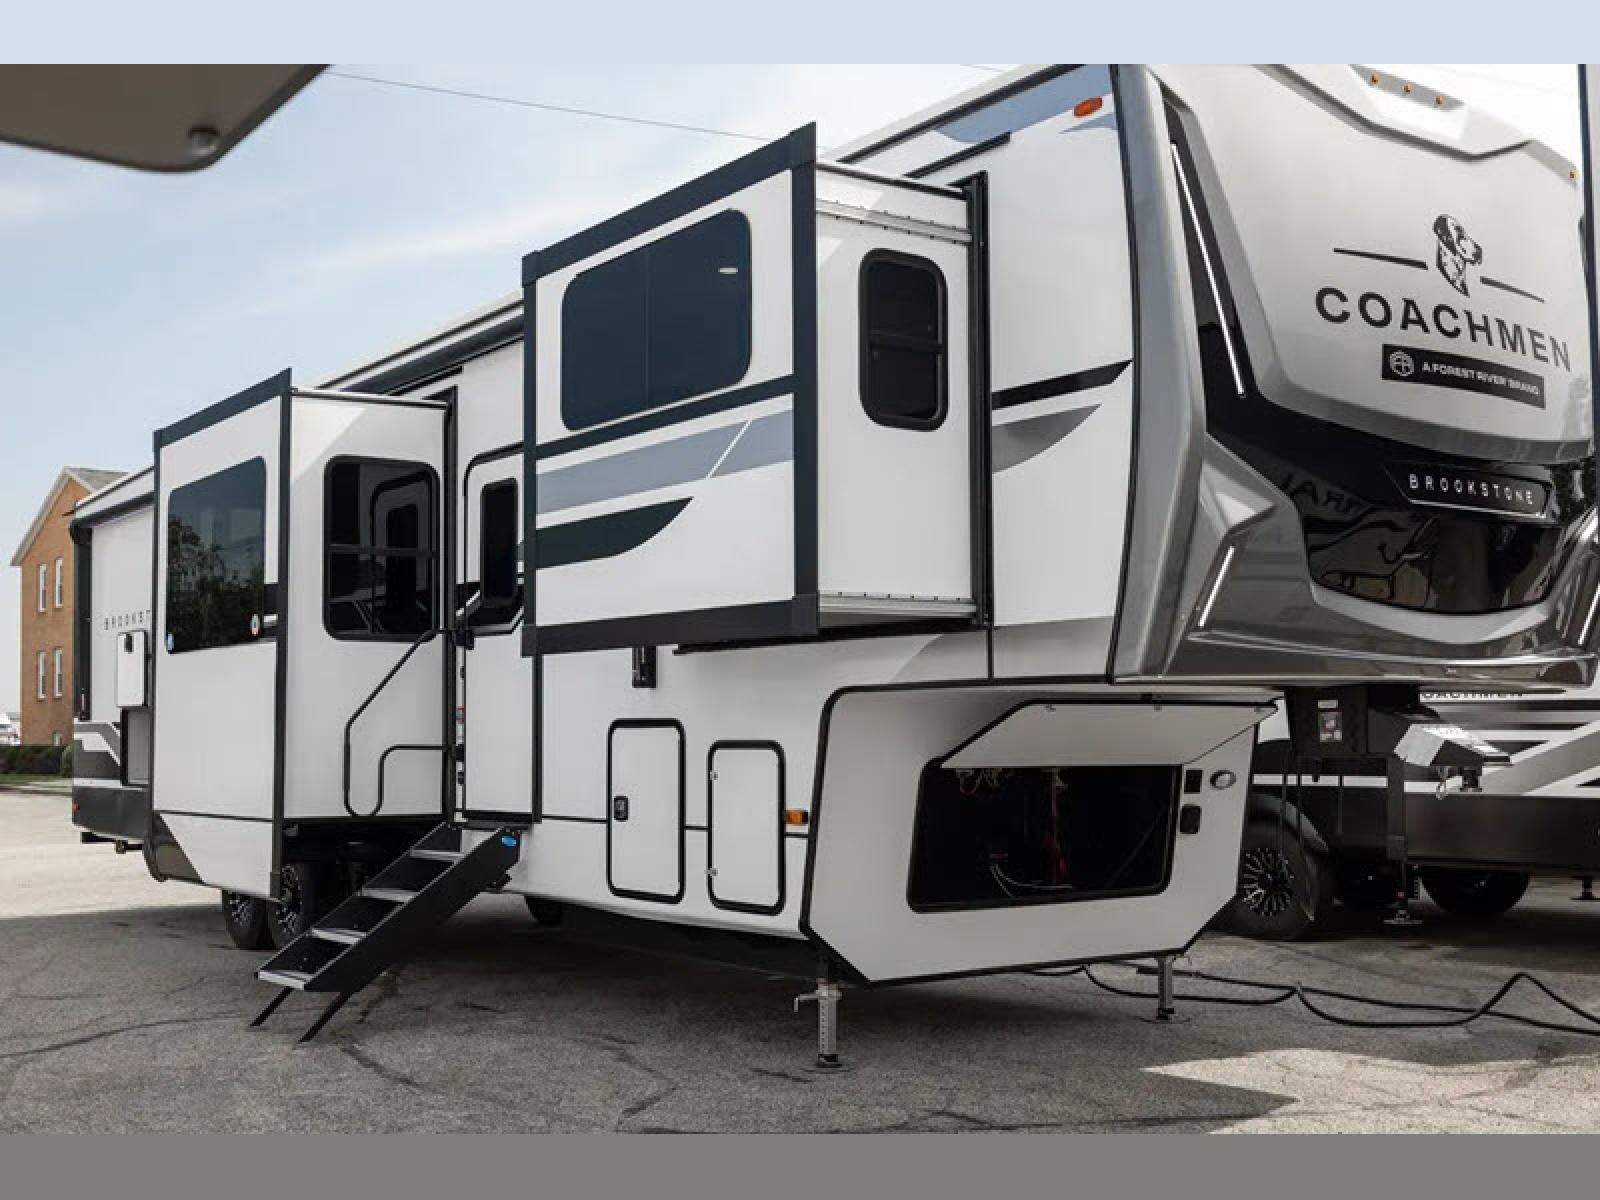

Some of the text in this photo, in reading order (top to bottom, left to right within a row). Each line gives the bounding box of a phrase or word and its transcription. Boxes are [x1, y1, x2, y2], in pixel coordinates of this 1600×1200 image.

[1315, 286, 1571, 372] COACHMEN
[1409, 473, 1534, 505] BROOKSTONE
[104, 609, 151, 631] BROOKST
